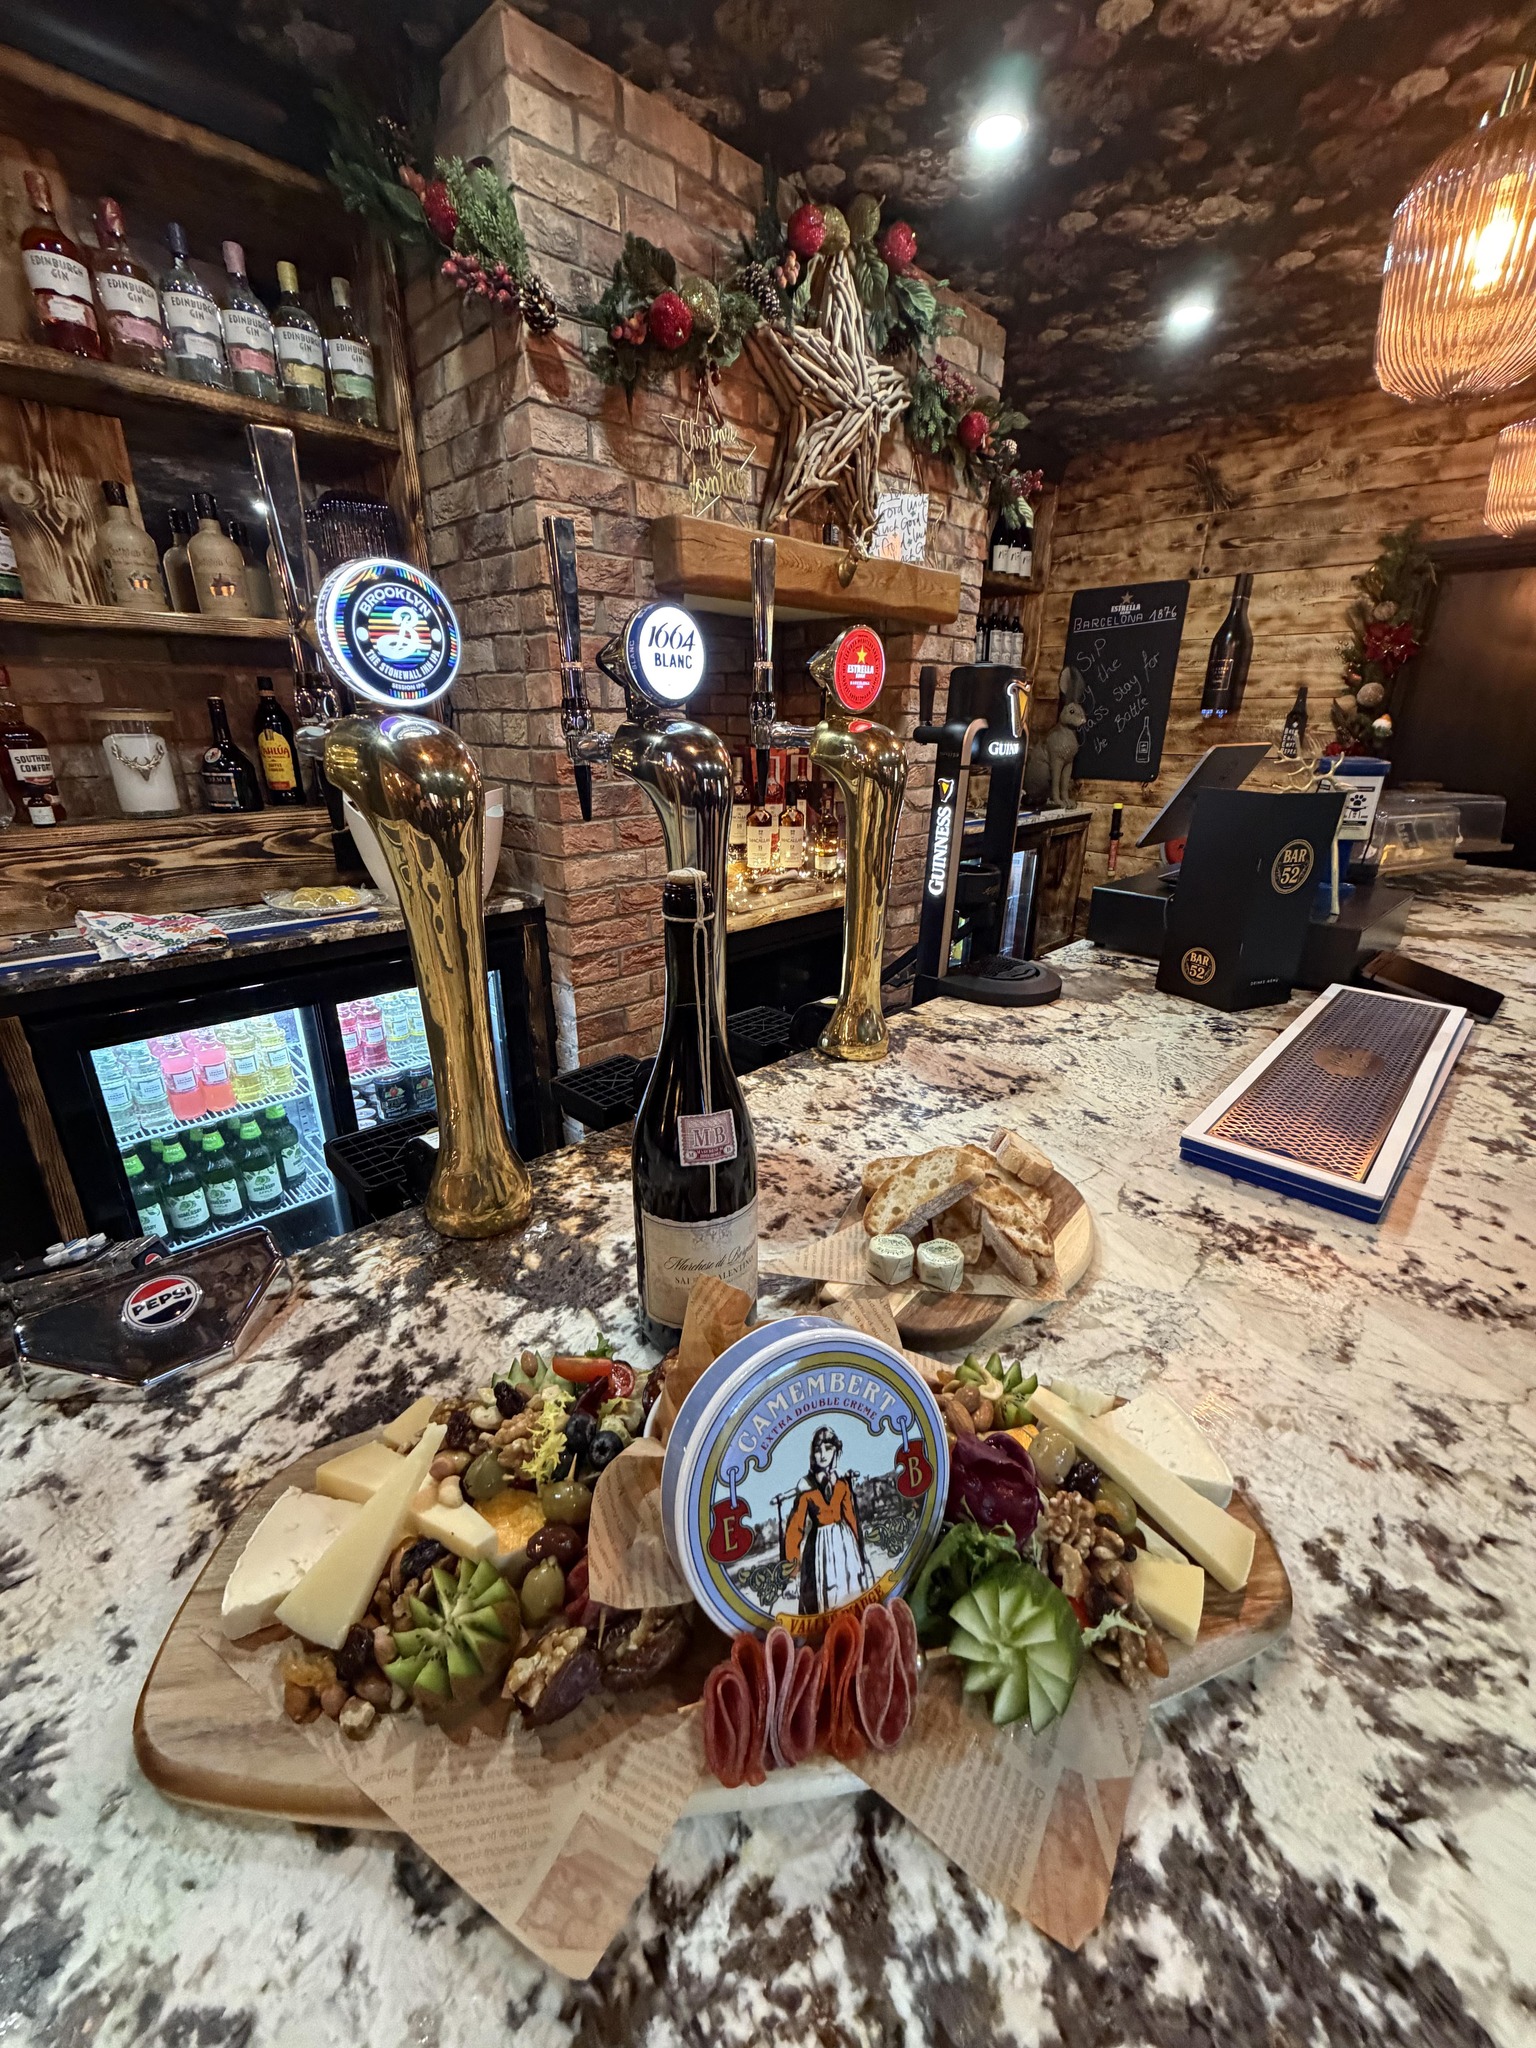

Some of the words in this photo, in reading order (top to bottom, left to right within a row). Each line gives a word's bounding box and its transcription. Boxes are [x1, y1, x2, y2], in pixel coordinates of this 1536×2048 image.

[51, 270, 69, 281] GIN
[127, 292, 144, 303] GIN
[190, 309, 204, 320] GIN
[228, 314, 270, 331] EDINBURG
[246, 326, 260, 337] GIN
[282, 331, 320, 347] EDINBURG
[299, 343, 312, 352] GIN
[352, 354, 364, 363] GIN
[359, 587, 432, 618] BROOKLYN
[1110, 603, 1141, 613] ESTRELLA
[1073, 613, 1144, 631] BARCELONA
[1149, 605, 1178, 622] 1876
[648, 622, 696, 652] 1664
[629, 640, 638, 670] BLANC
[654, 653, 693, 669] BLANC
[366, 649, 381, 667] THE
[379, 662, 422, 681] STONEWALL
[420, 661, 434, 675] INN
[429, 649, 441, 664] IPA
[1098, 658, 1122, 683] the
[1142, 650, 1160, 683] for
[391, 683, 416, 691] SESSION
[262, 745, 290, 758] AHLÚA
[1094, 737, 1109, 754] the
[928, 806, 952, 896] GUINNESS
[1283, 849, 1307, 863] BAR
[1280, 866, 1300, 885] 52
[1190, 952, 1209, 966] BAR
[1189, 965, 1206, 979] 52
[664, 1256, 714, 1271] Marchese
[715, 1254, 727, 1267] di
[132, 1285, 192, 1317] PEPSI
[738, 1372, 896, 1453] CAMEMBERT
[760, 1414, 793, 1451] EXTRA
[794, 1397, 840, 1417] DOUBLE
[843, 1398, 878, 1420] CREME
[908, 1456, 923, 1488] B
[725, 1516, 738, 1552] E
